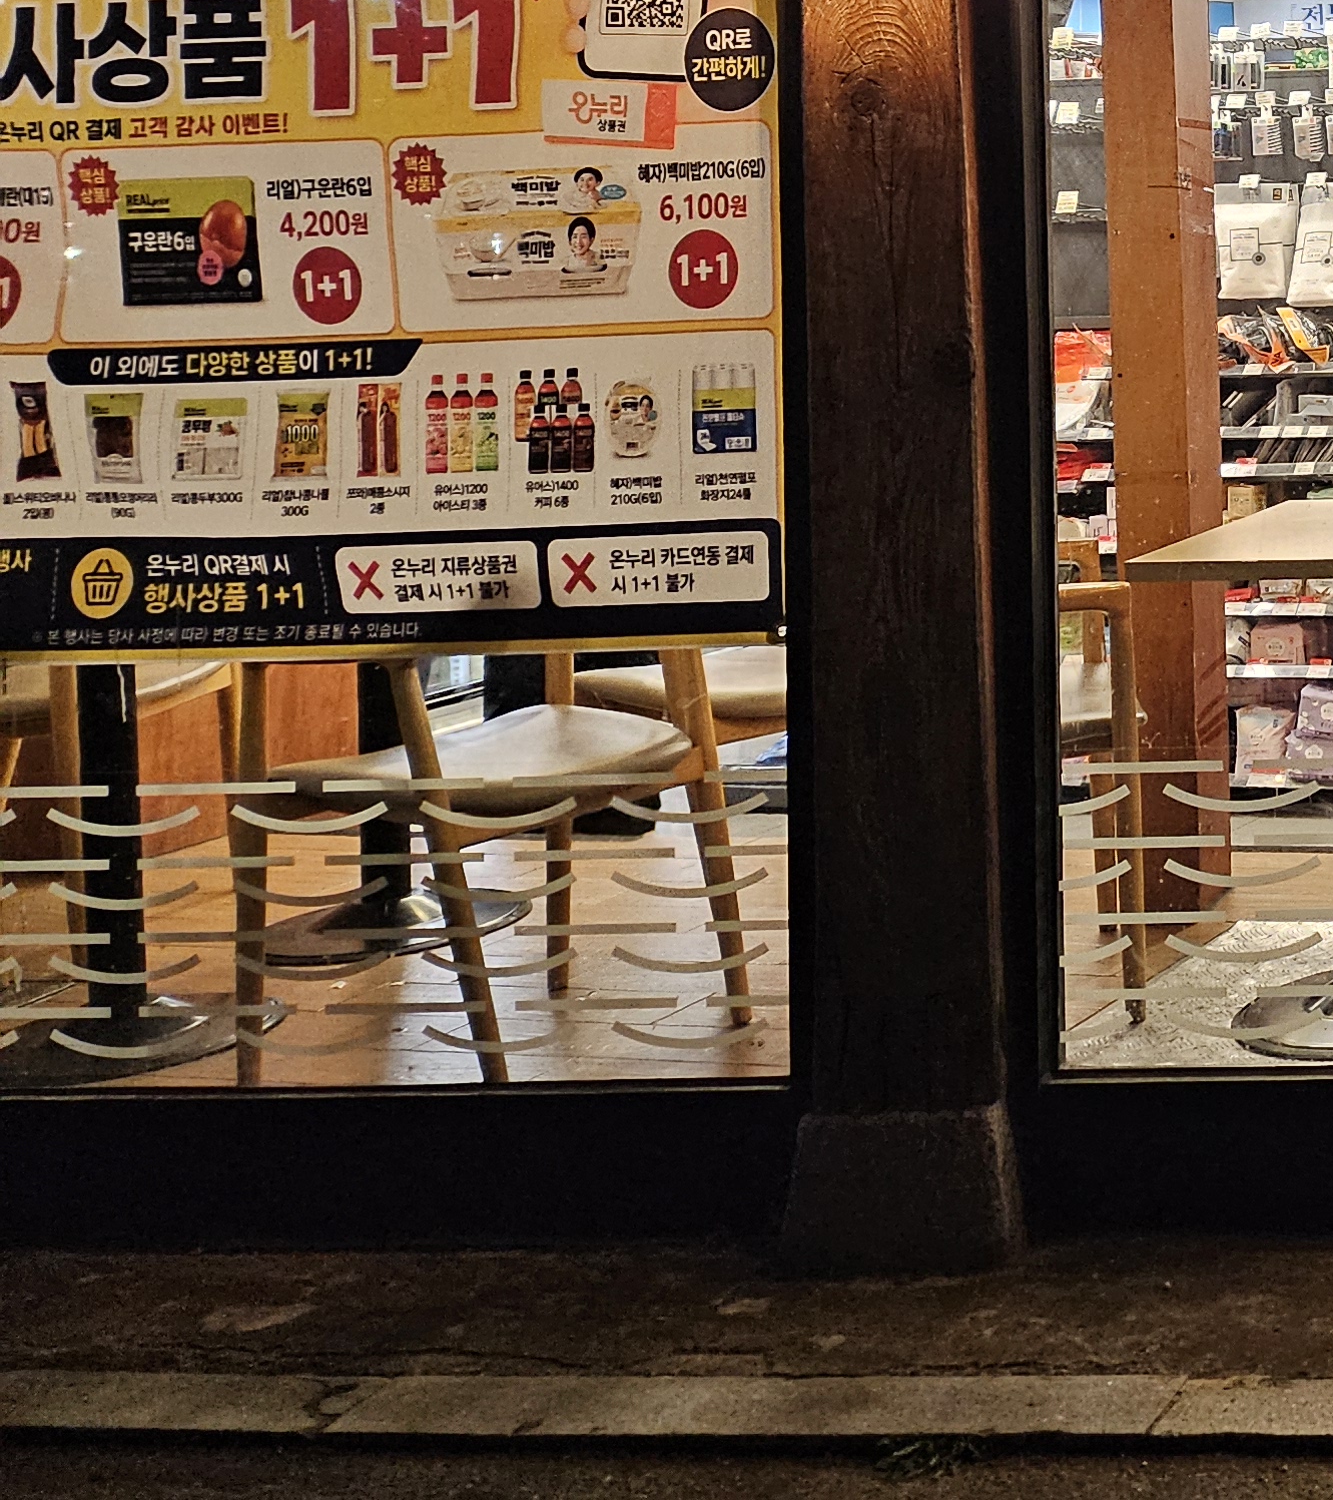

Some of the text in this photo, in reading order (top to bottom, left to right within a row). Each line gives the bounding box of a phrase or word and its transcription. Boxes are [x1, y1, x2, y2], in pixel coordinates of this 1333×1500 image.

[705, 28, 752, 51] QR로
[691, 56, 767, 82] 간편하게!
[568, 90, 628, 125] 온누리
[49, 121, 80, 142] QR
[85, 119, 122, 142] 결제
[128, 116, 168, 141] 고객
[174, 115, 216, 139] 감사
[222, 112, 289, 137] 이벤트!
[597, 119, 626, 132] 상품권
[404, 155, 431, 173] 핵심
[637, 158, 765, 184] 혜자)백미밥210G(6입)
[265, 176, 372, 201] 리얼)구운란6입
[404, 174, 437, 193] 상품!
[659, 193, 747, 225] 6,100원
[279, 210, 370, 240] 4,200원
[128, 231, 196, 253] 구운란6입
[675, 251, 728, 287] 1+1
[300, 269, 353, 303] 1+1
[90, 347, 373, 378] 이 외에도 다양한 상품이 1+1!
[281, 505, 309, 517] 300G
[145, 553, 291, 577] 온누리 QR결제 시
[391, 554, 518, 578] 온누리 지류상품권
[608, 544, 755, 570] 온누리 카드연동 결제
[393, 579, 509, 602] 결제 시 1+1 불가
[611, 572, 695, 596] 시 1+1 불가
[143, 581, 305, 614] 행사상품 1+1
[181, 626, 209, 642] 따라
[212, 625, 239, 642] 변경
[242, 625, 269, 641] 또는
[273, 624, 300, 641] 조기
[304, 623, 345, 640] 종료될
[349, 624, 363, 639] 수
[366, 623, 422, 638] 있습니다.
